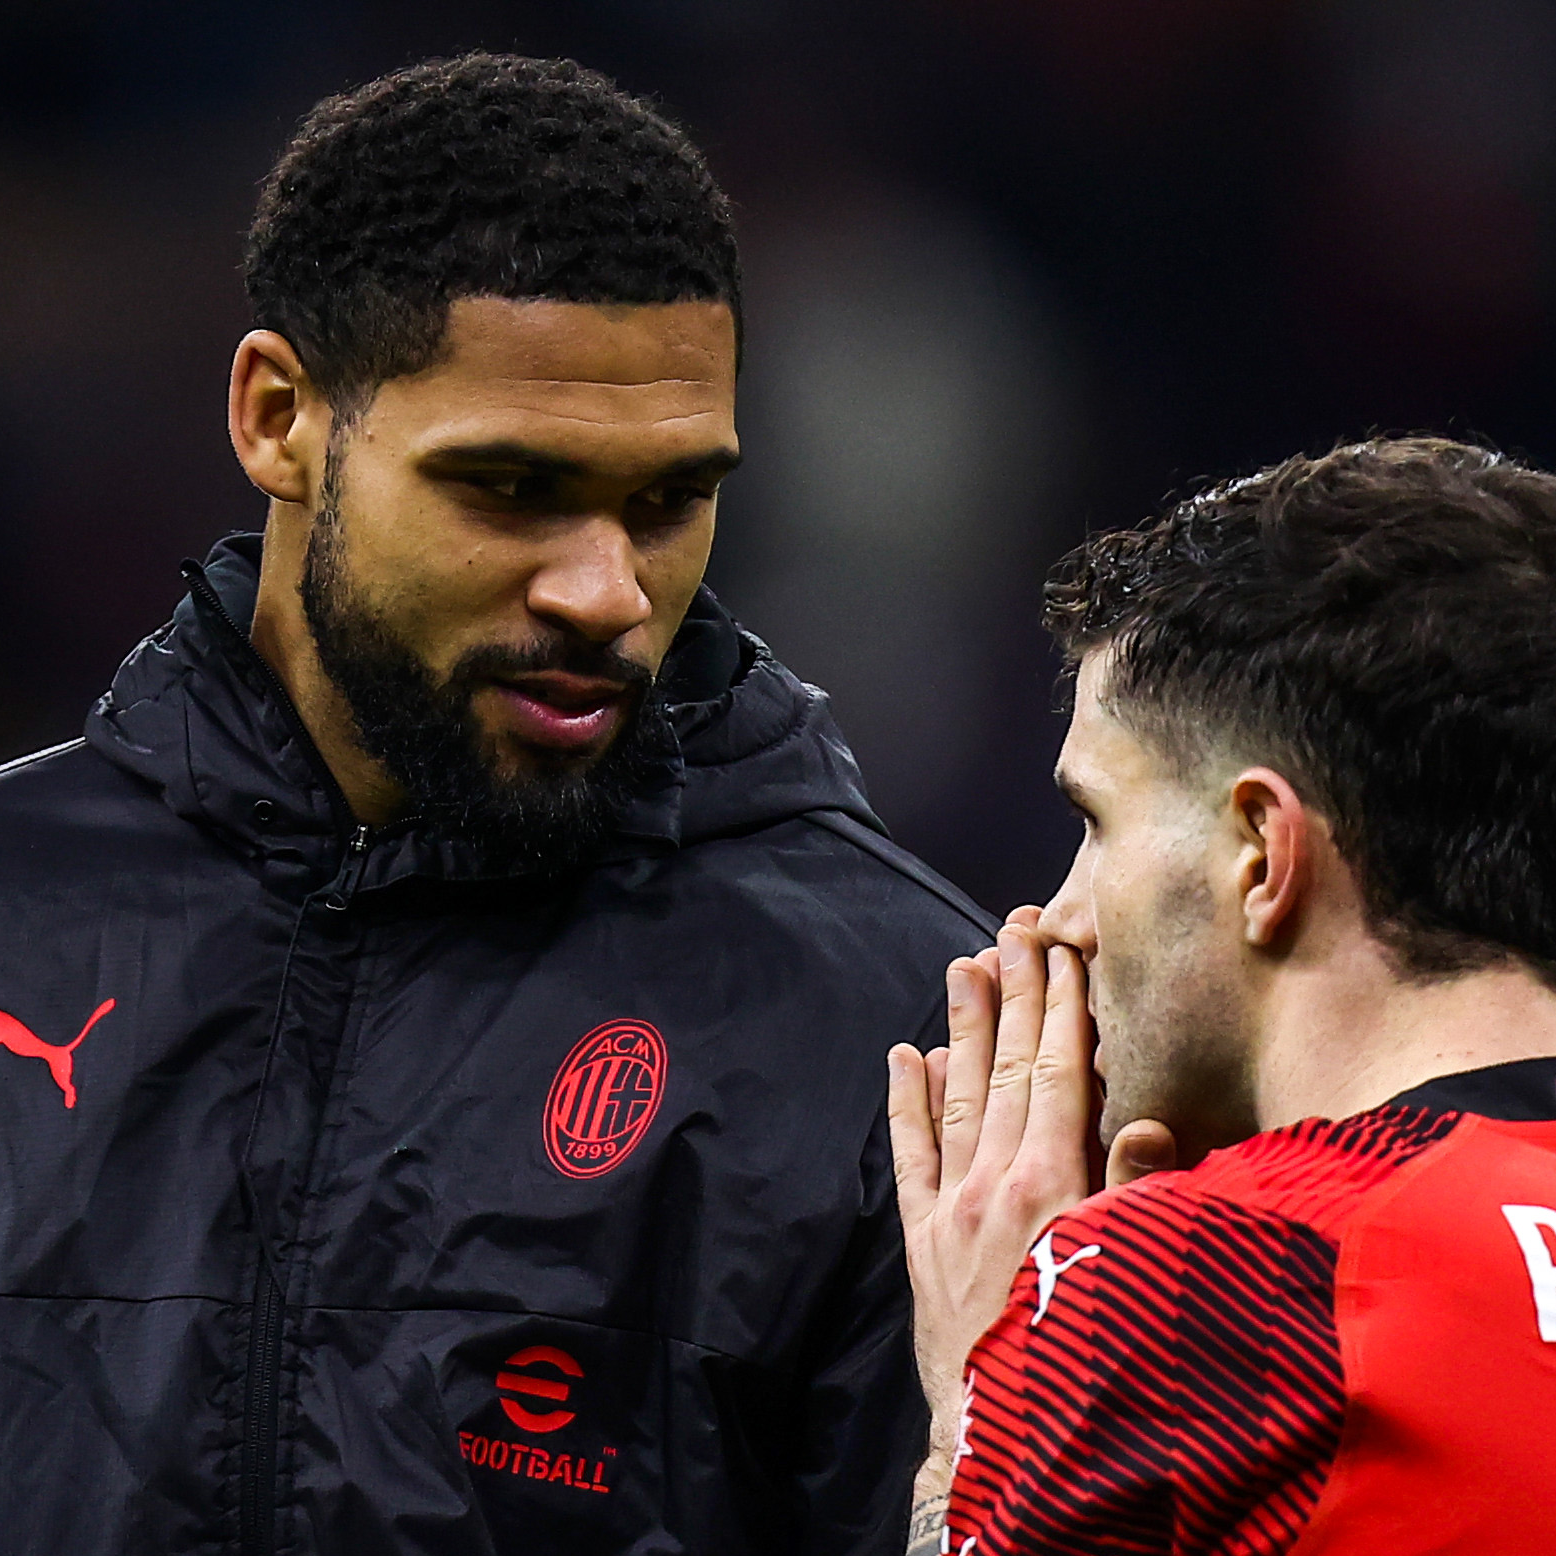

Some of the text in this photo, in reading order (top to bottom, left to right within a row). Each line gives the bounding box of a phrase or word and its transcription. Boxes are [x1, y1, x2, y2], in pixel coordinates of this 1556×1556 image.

[587, 1033, 650, 1061] ACM
[564, 1141, 618, 1160] 1899
[457, 1431, 611, 1494] FOOTBALL
